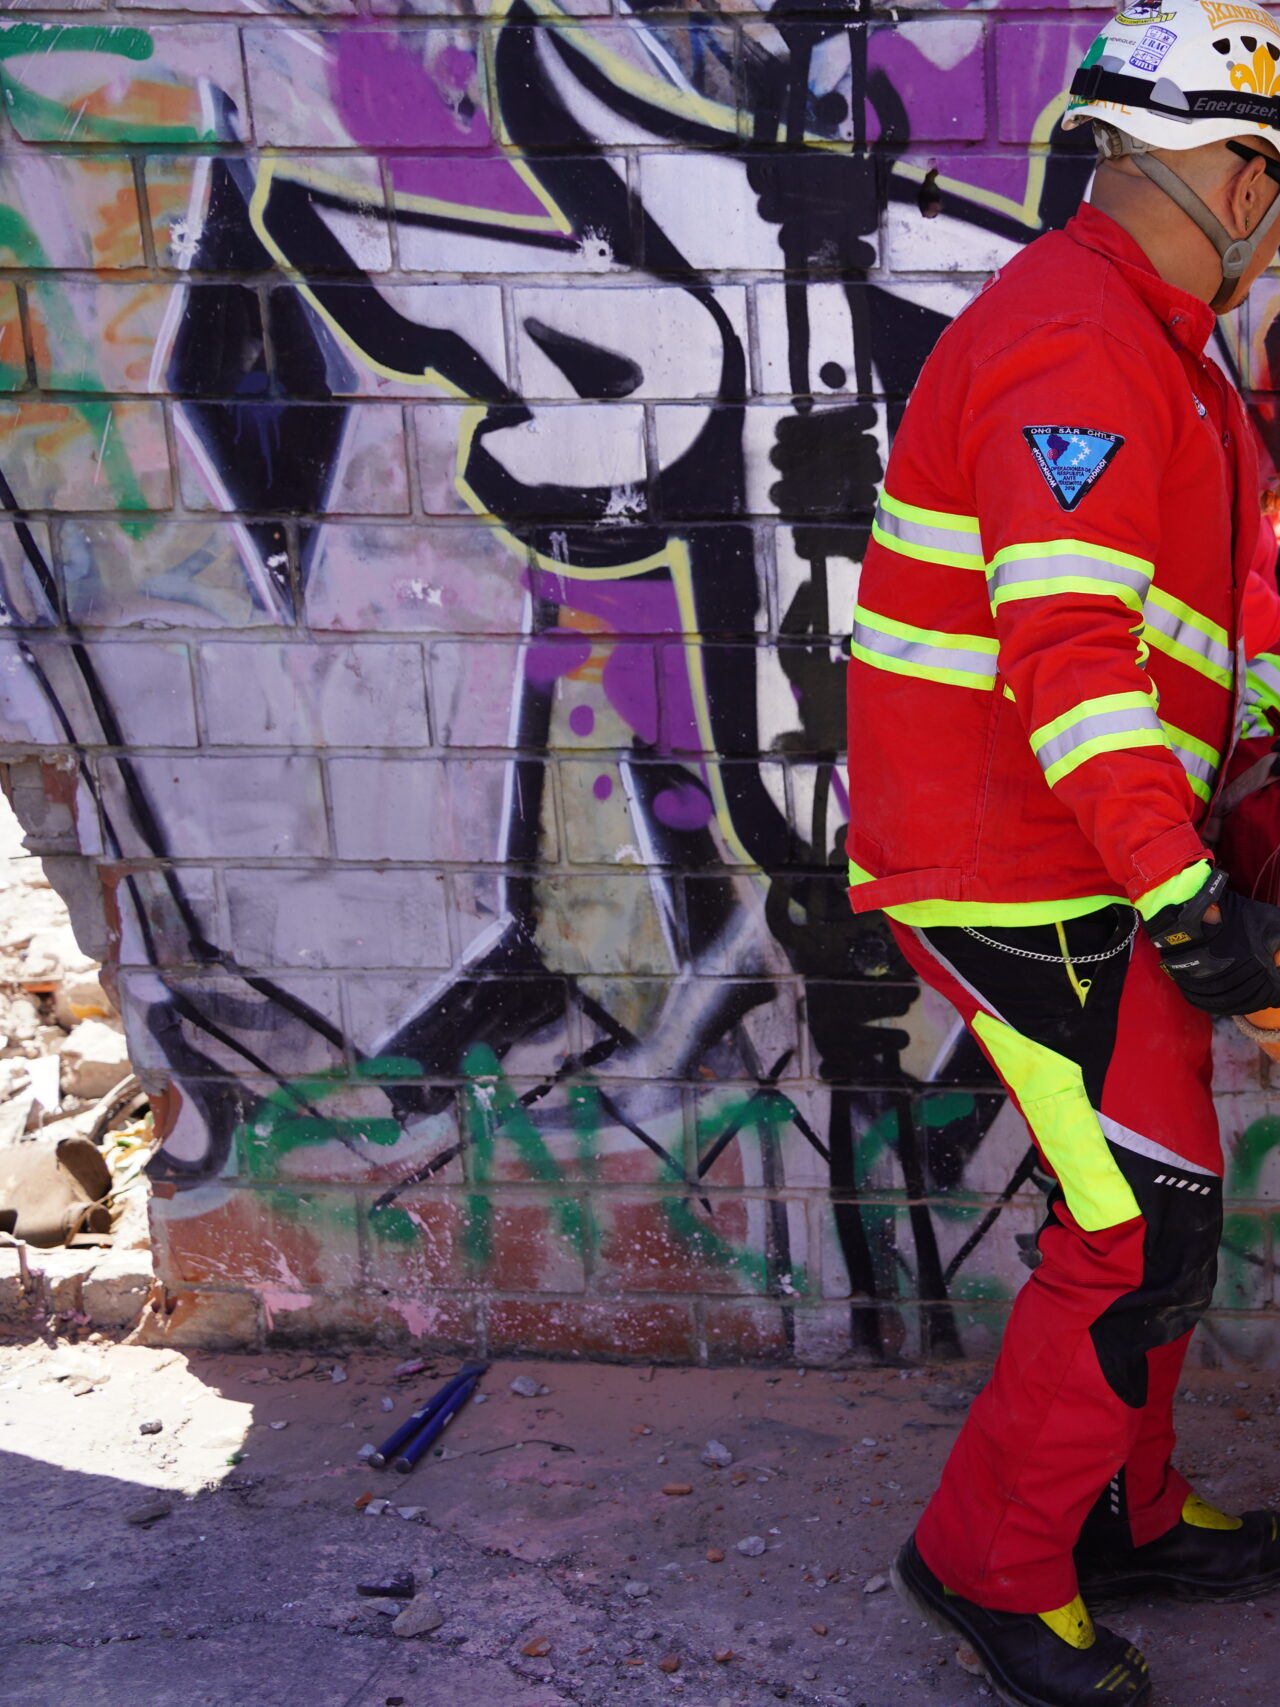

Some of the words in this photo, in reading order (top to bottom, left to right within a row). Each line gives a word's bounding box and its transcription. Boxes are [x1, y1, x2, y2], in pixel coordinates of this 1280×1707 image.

[1141, 37, 1169, 53] URAC
[1087, 429, 1116, 442] CHILE
[1032, 446, 1057, 488] WORKSHOP
[1086, 458, 1108, 484] IQUIQUE
